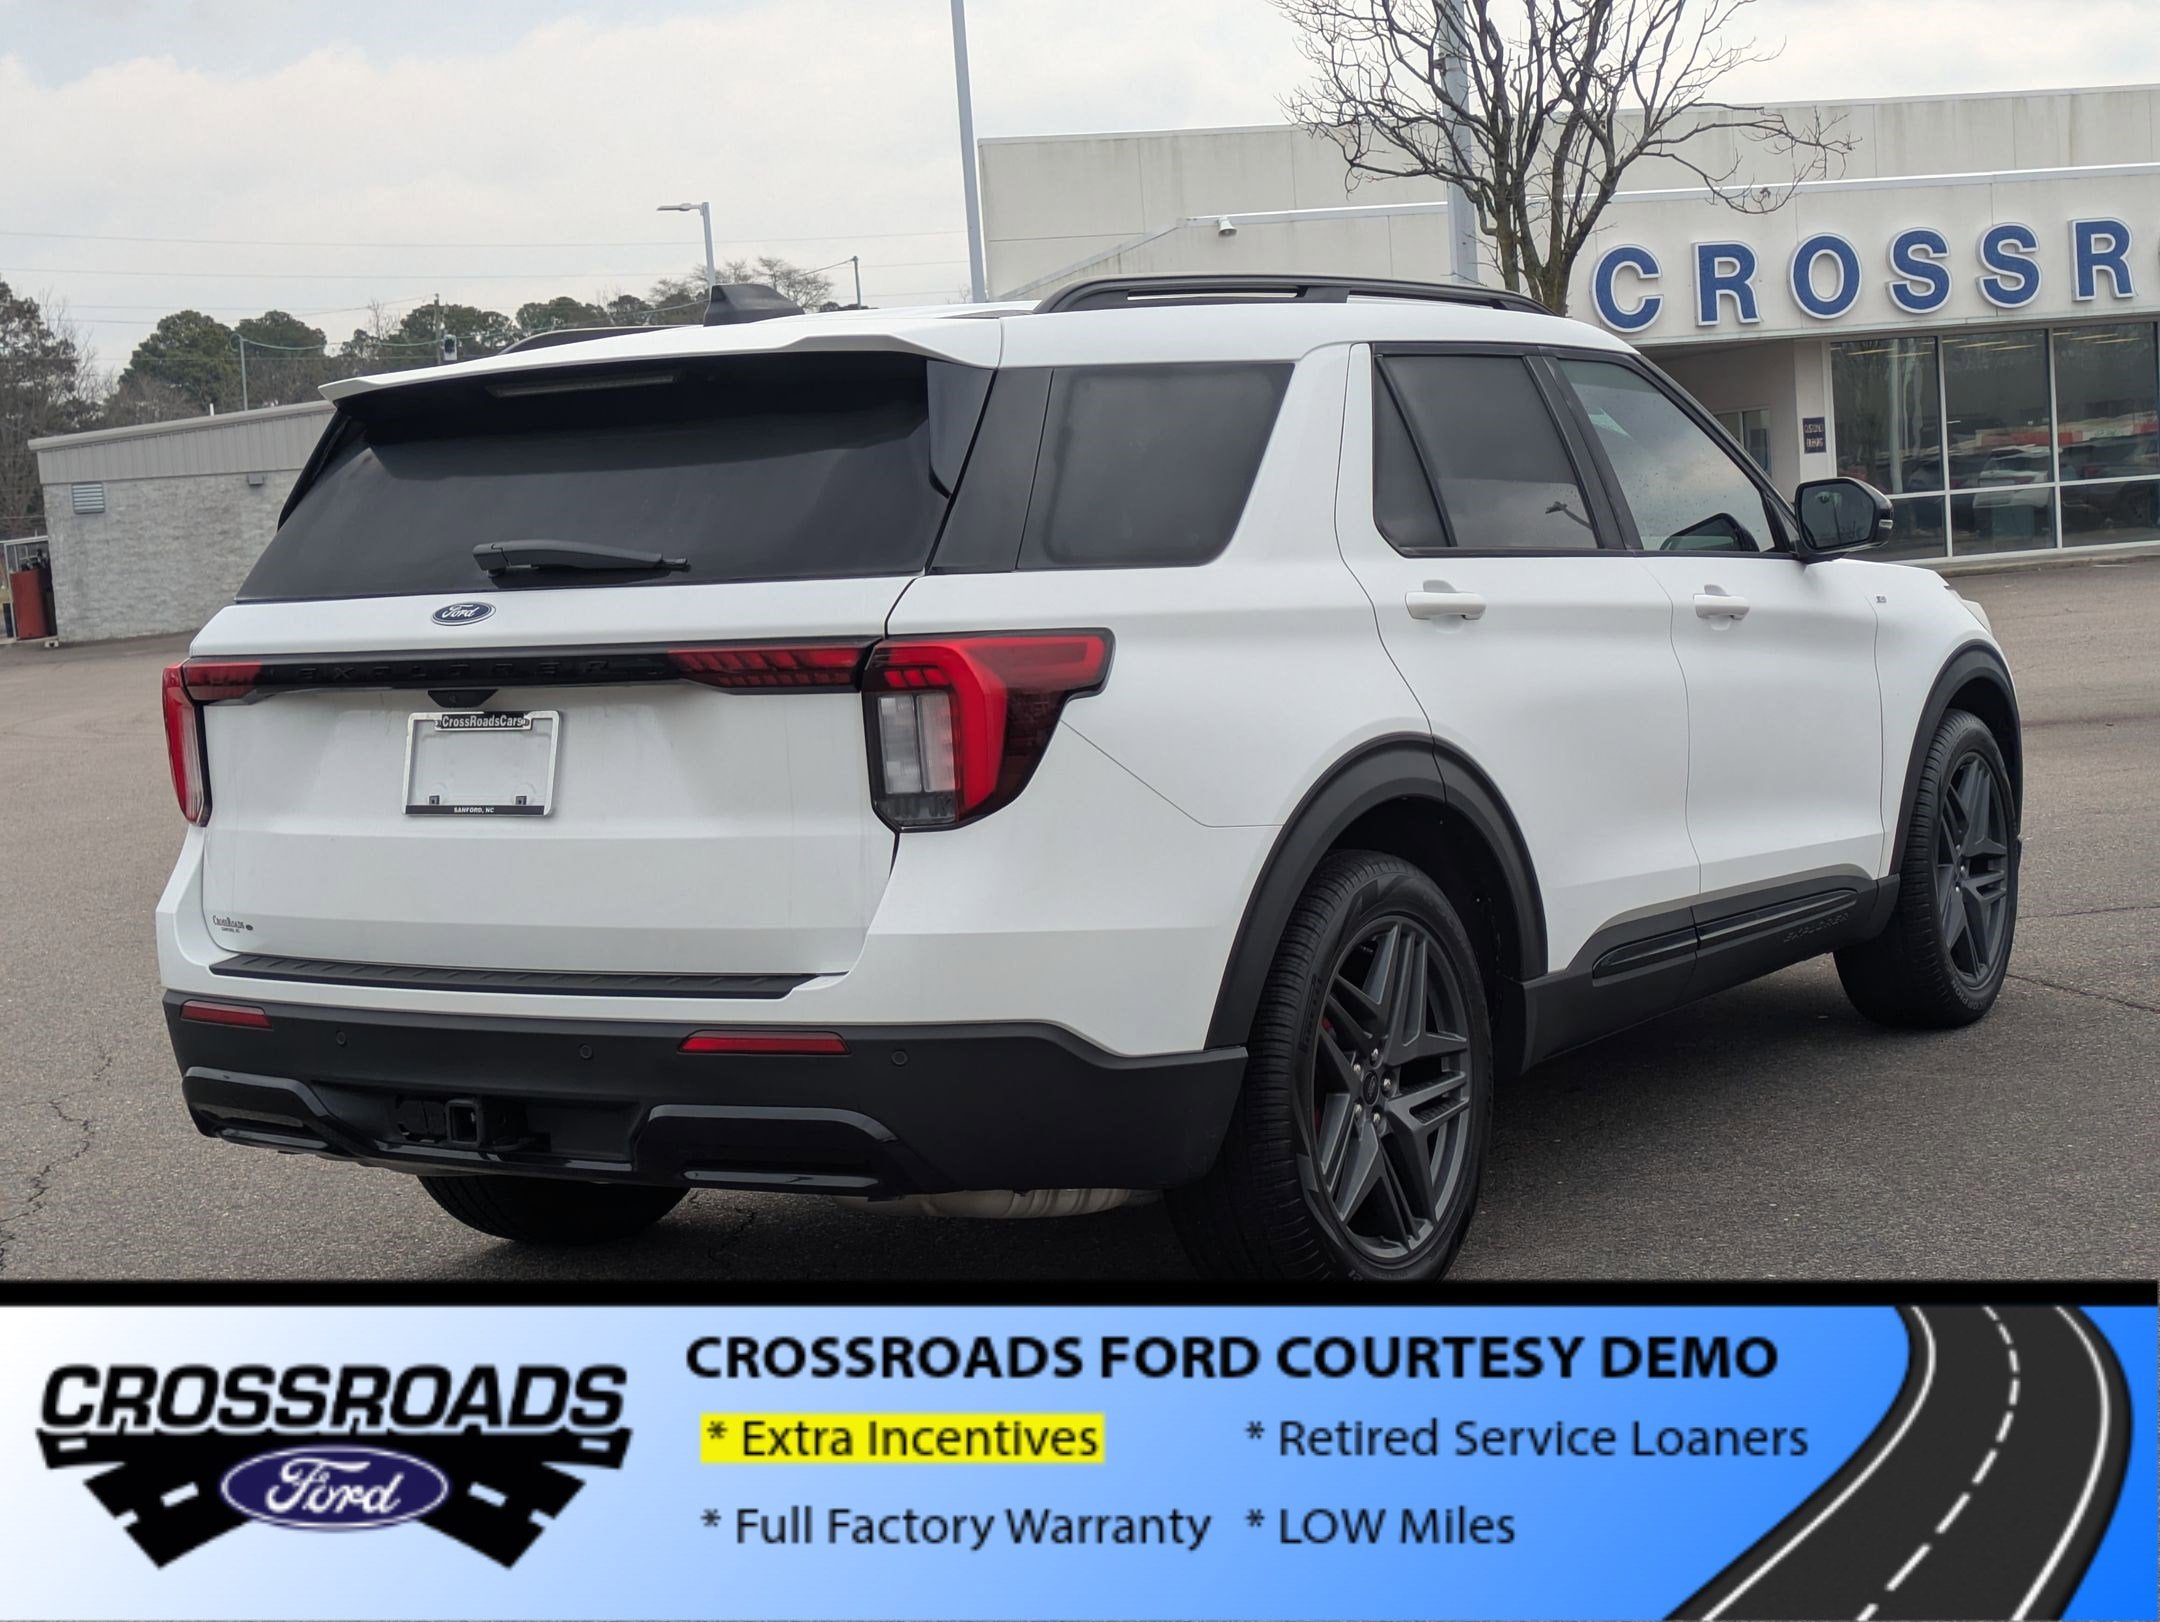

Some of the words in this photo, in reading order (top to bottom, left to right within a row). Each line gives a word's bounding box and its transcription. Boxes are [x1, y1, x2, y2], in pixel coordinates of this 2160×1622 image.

[1590, 217, 2160, 333] CROSSR
[441, 604, 480, 619] Ford
[442, 714, 526, 728] CrossRoadsCars
